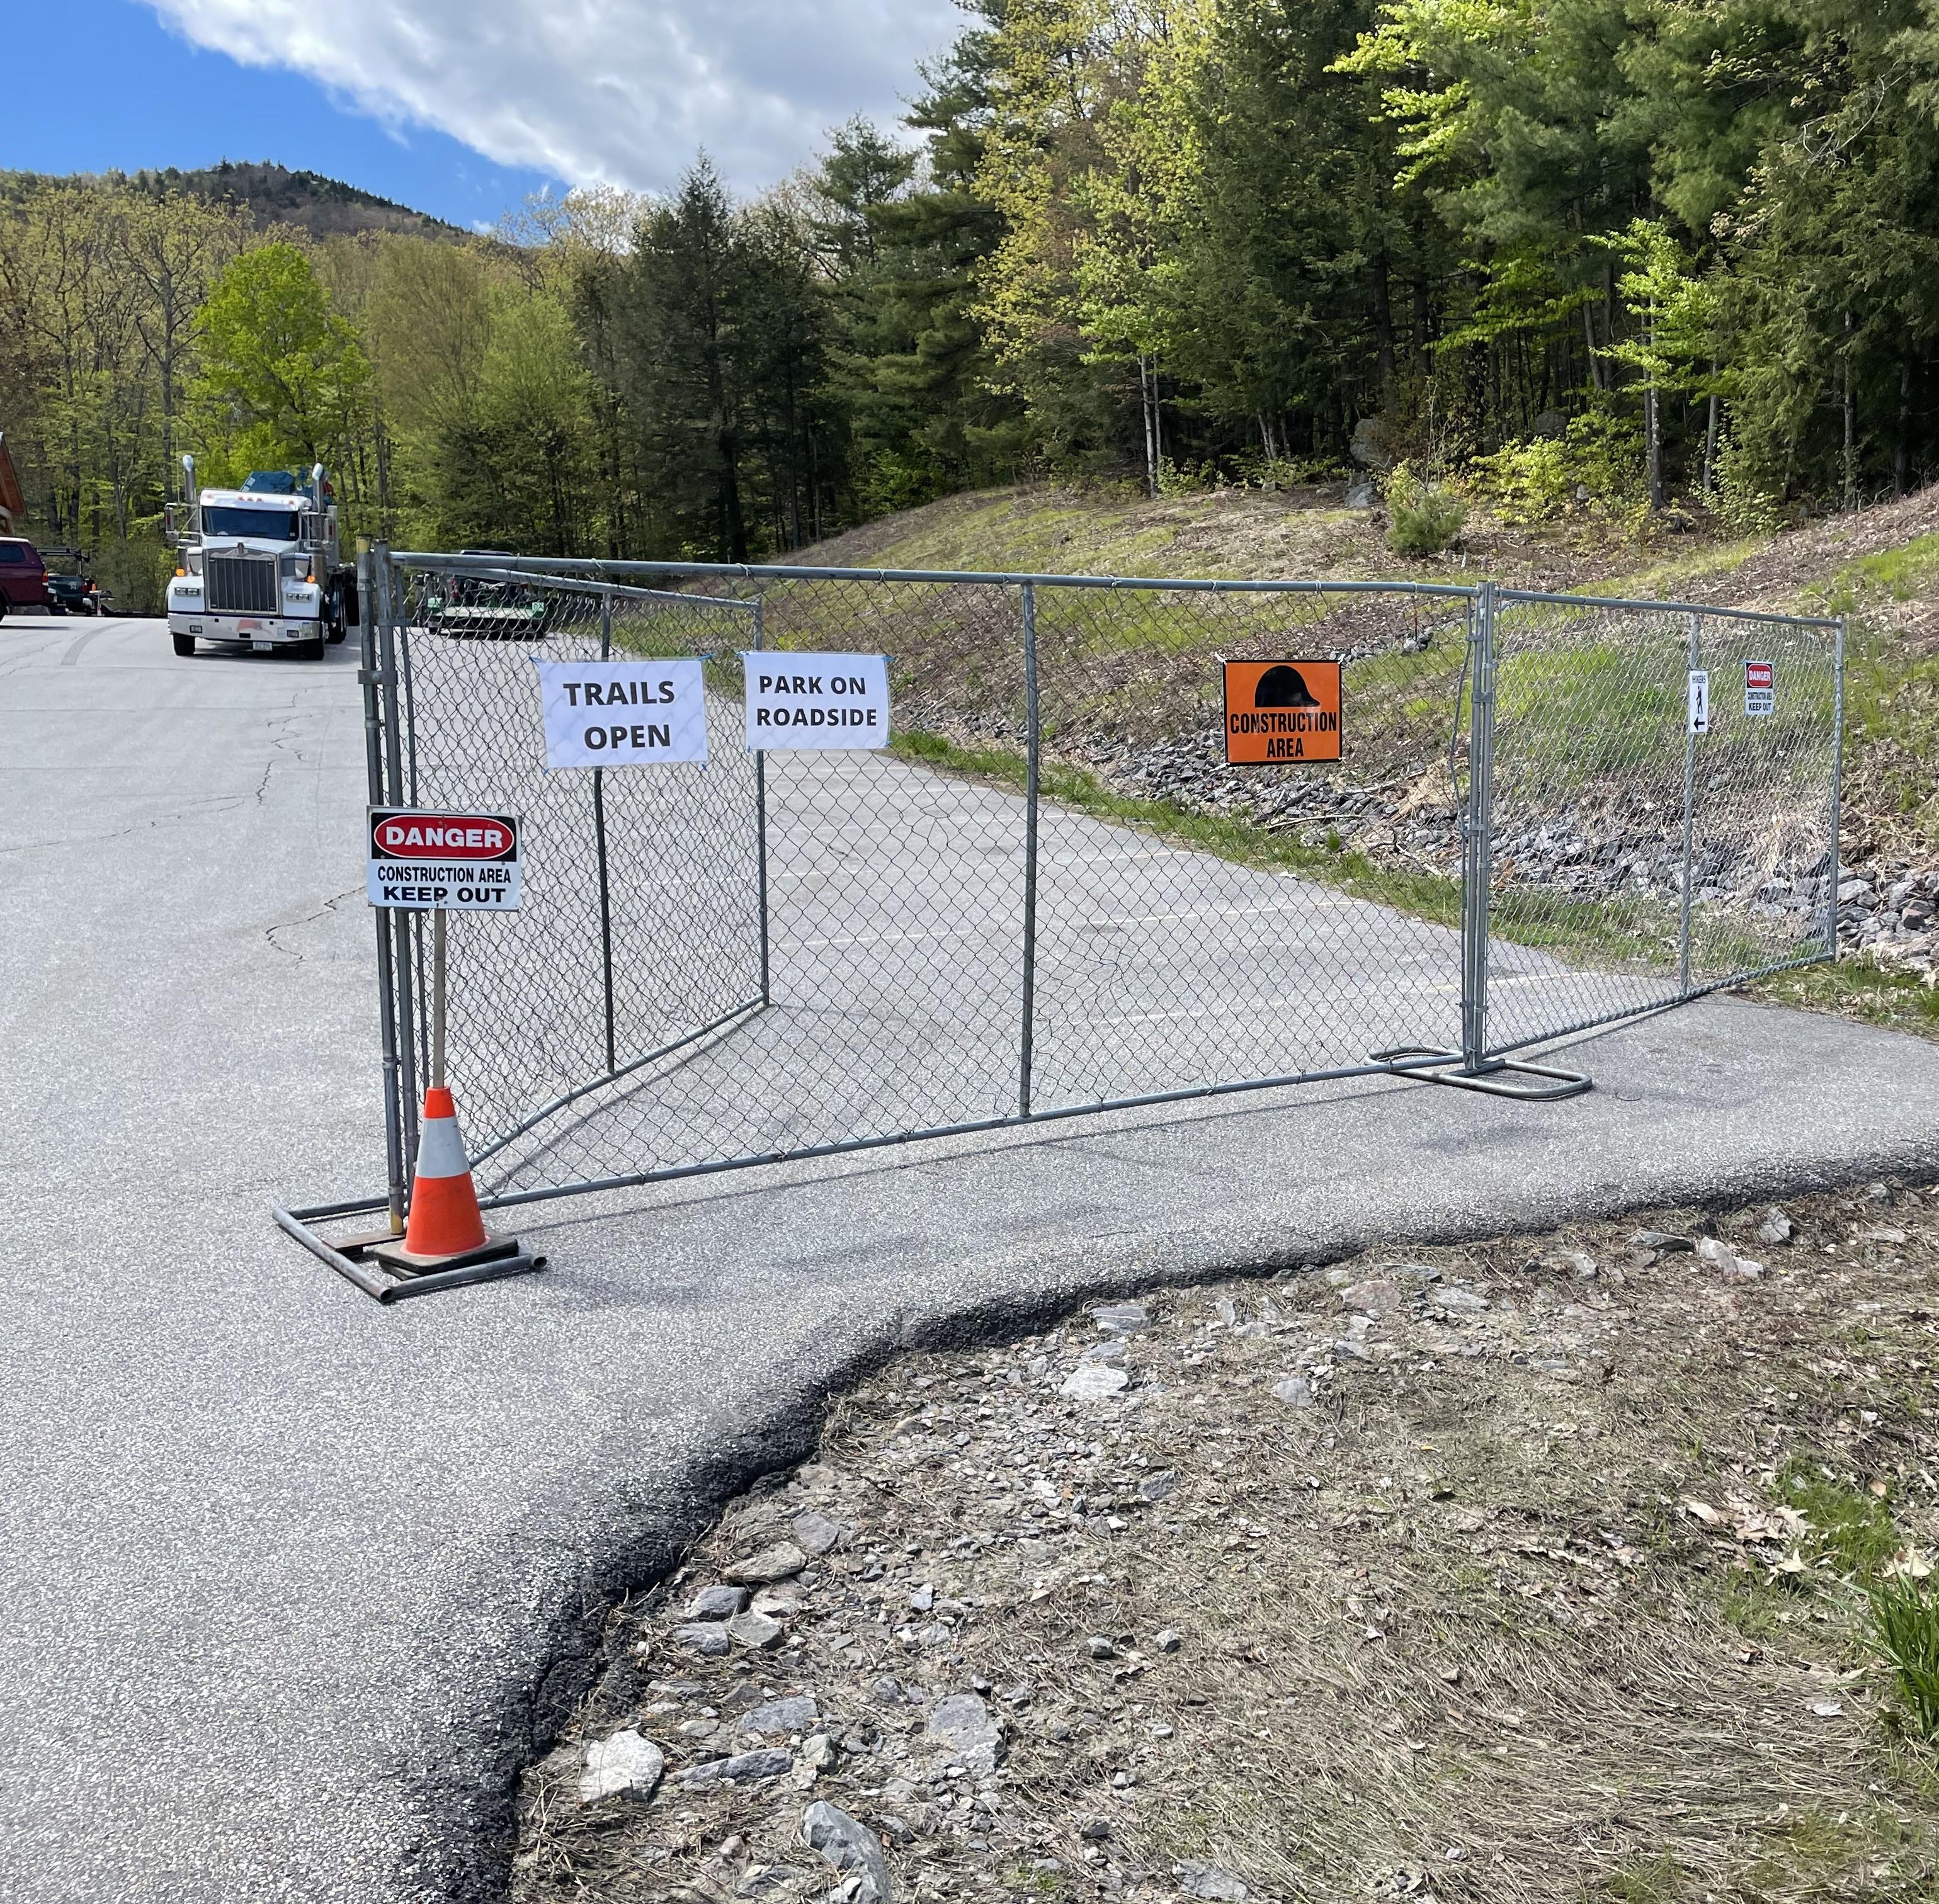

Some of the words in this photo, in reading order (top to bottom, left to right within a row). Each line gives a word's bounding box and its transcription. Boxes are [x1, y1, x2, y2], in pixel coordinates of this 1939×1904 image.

[759, 675, 823, 694] PARK
[831, 677, 866, 695] ON
[1749, 670, 1771, 681] DANGER
[563, 681, 674, 706] TRAILS
[1749, 703, 1761, 711] KEEP
[1763, 703, 1771, 711] OUT
[757, 708, 877, 727] ROADSIDE
[1230, 712, 1337, 734] CONSTRUCTION
[584, 724, 671, 749] OPEN
[1266, 738, 1304, 758] AREA
[386, 826, 503, 848] DANGER
[378, 866, 474, 882] CONSTRUCTION
[479, 868, 511, 883] AREA
[384, 886, 448, 902] KEEP
[457, 888, 506, 903] OUT
